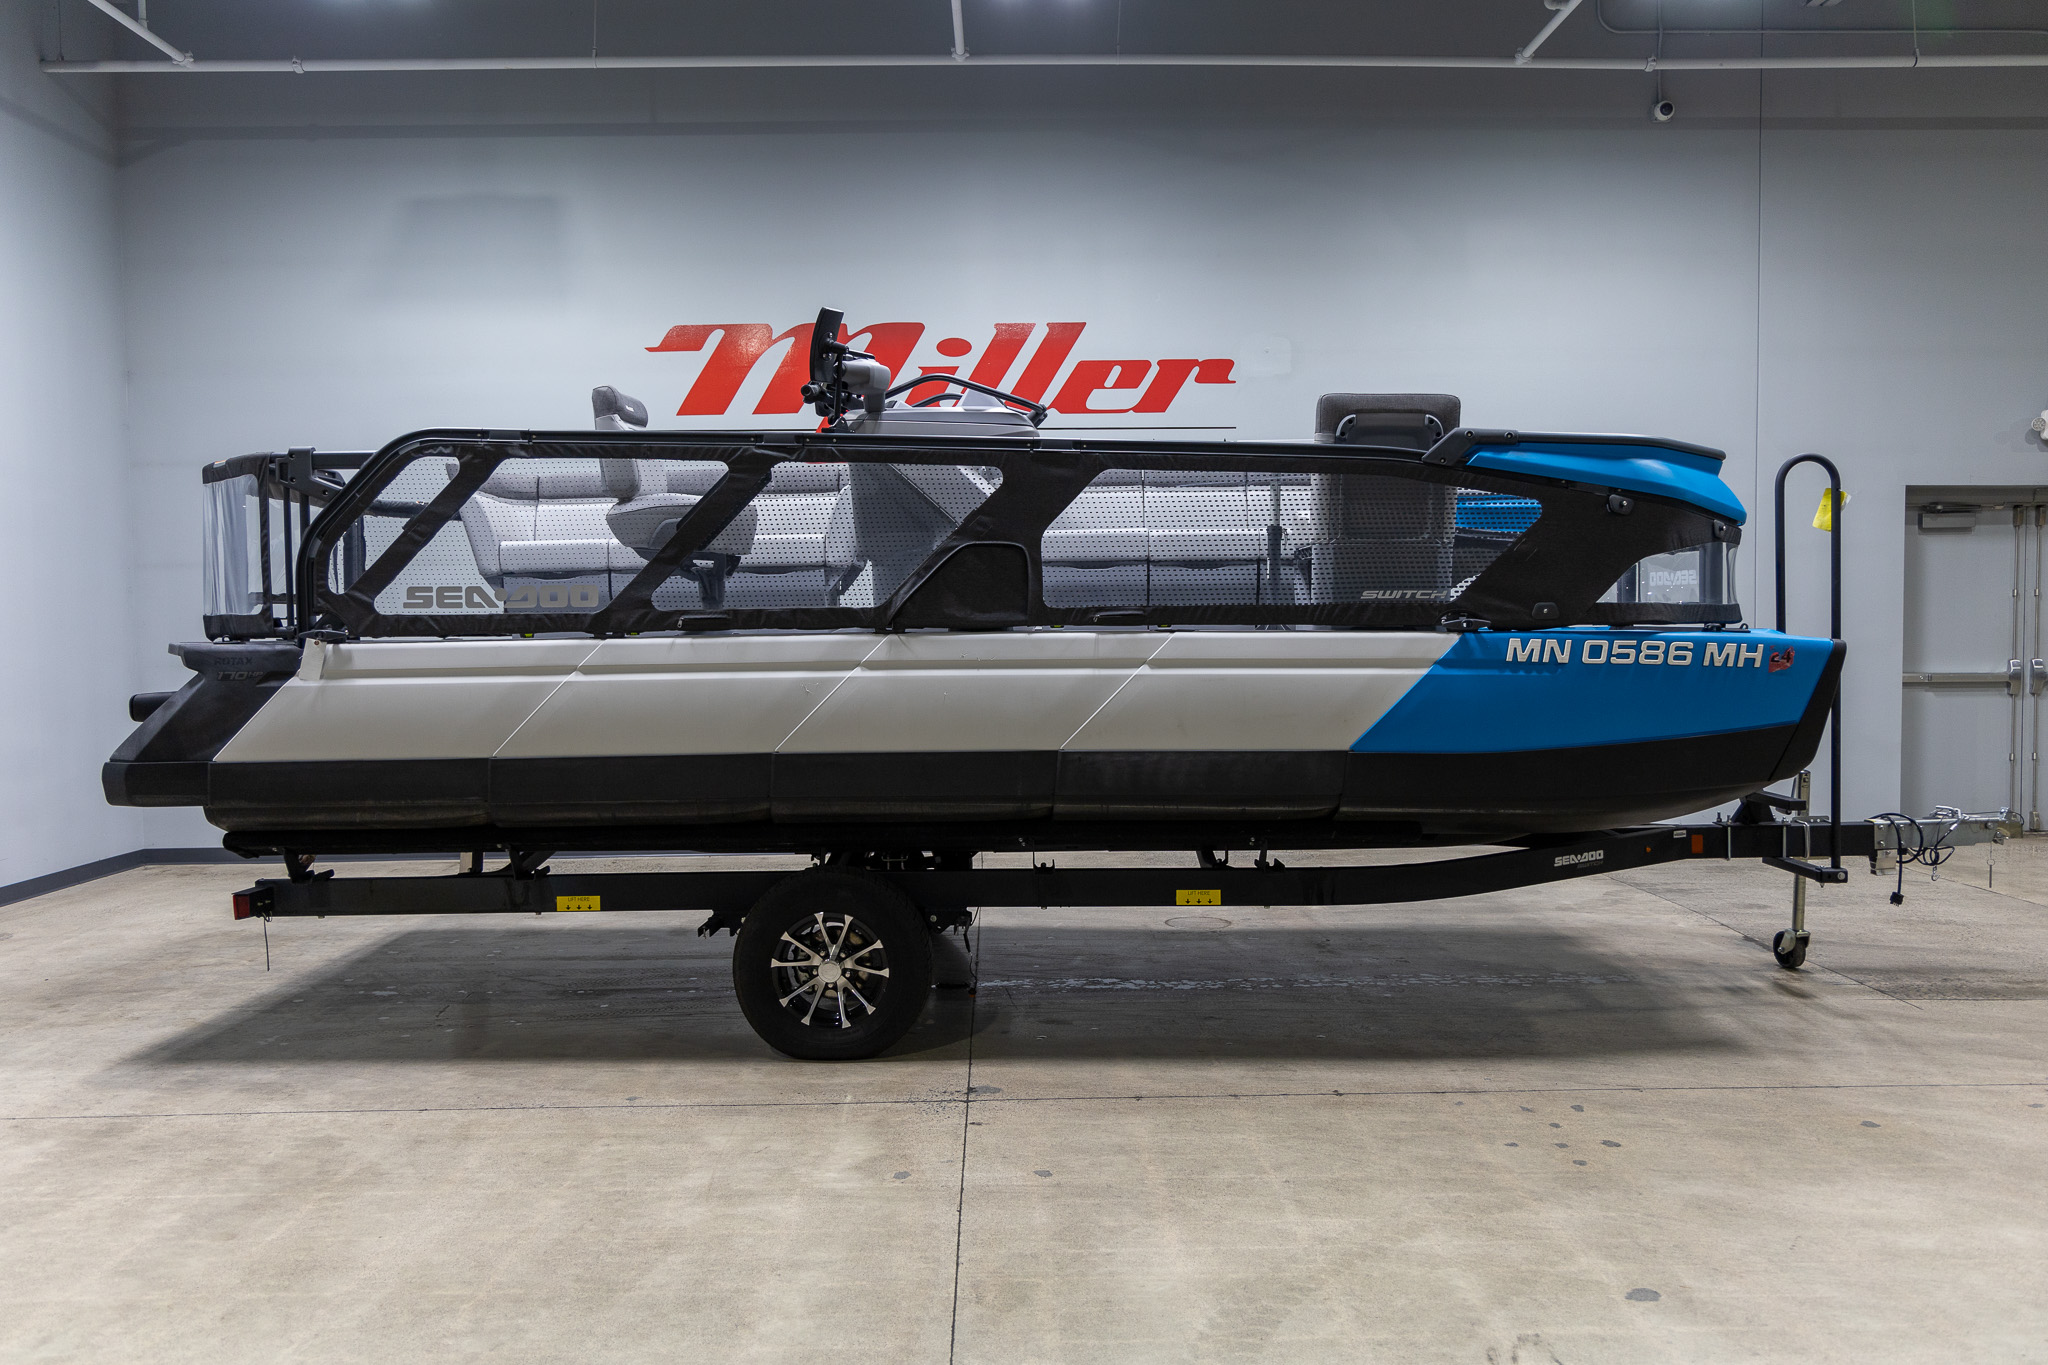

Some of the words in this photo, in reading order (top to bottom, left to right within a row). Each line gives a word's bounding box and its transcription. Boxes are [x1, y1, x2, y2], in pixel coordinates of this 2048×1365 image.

[644, 321, 1237, 418] Miller
[1360, 590, 1448, 599] SWITCH
[1505, 637, 1573, 664] MN
[1581, 639, 1694, 666] 0586
[1702, 642, 1764, 668] MH
